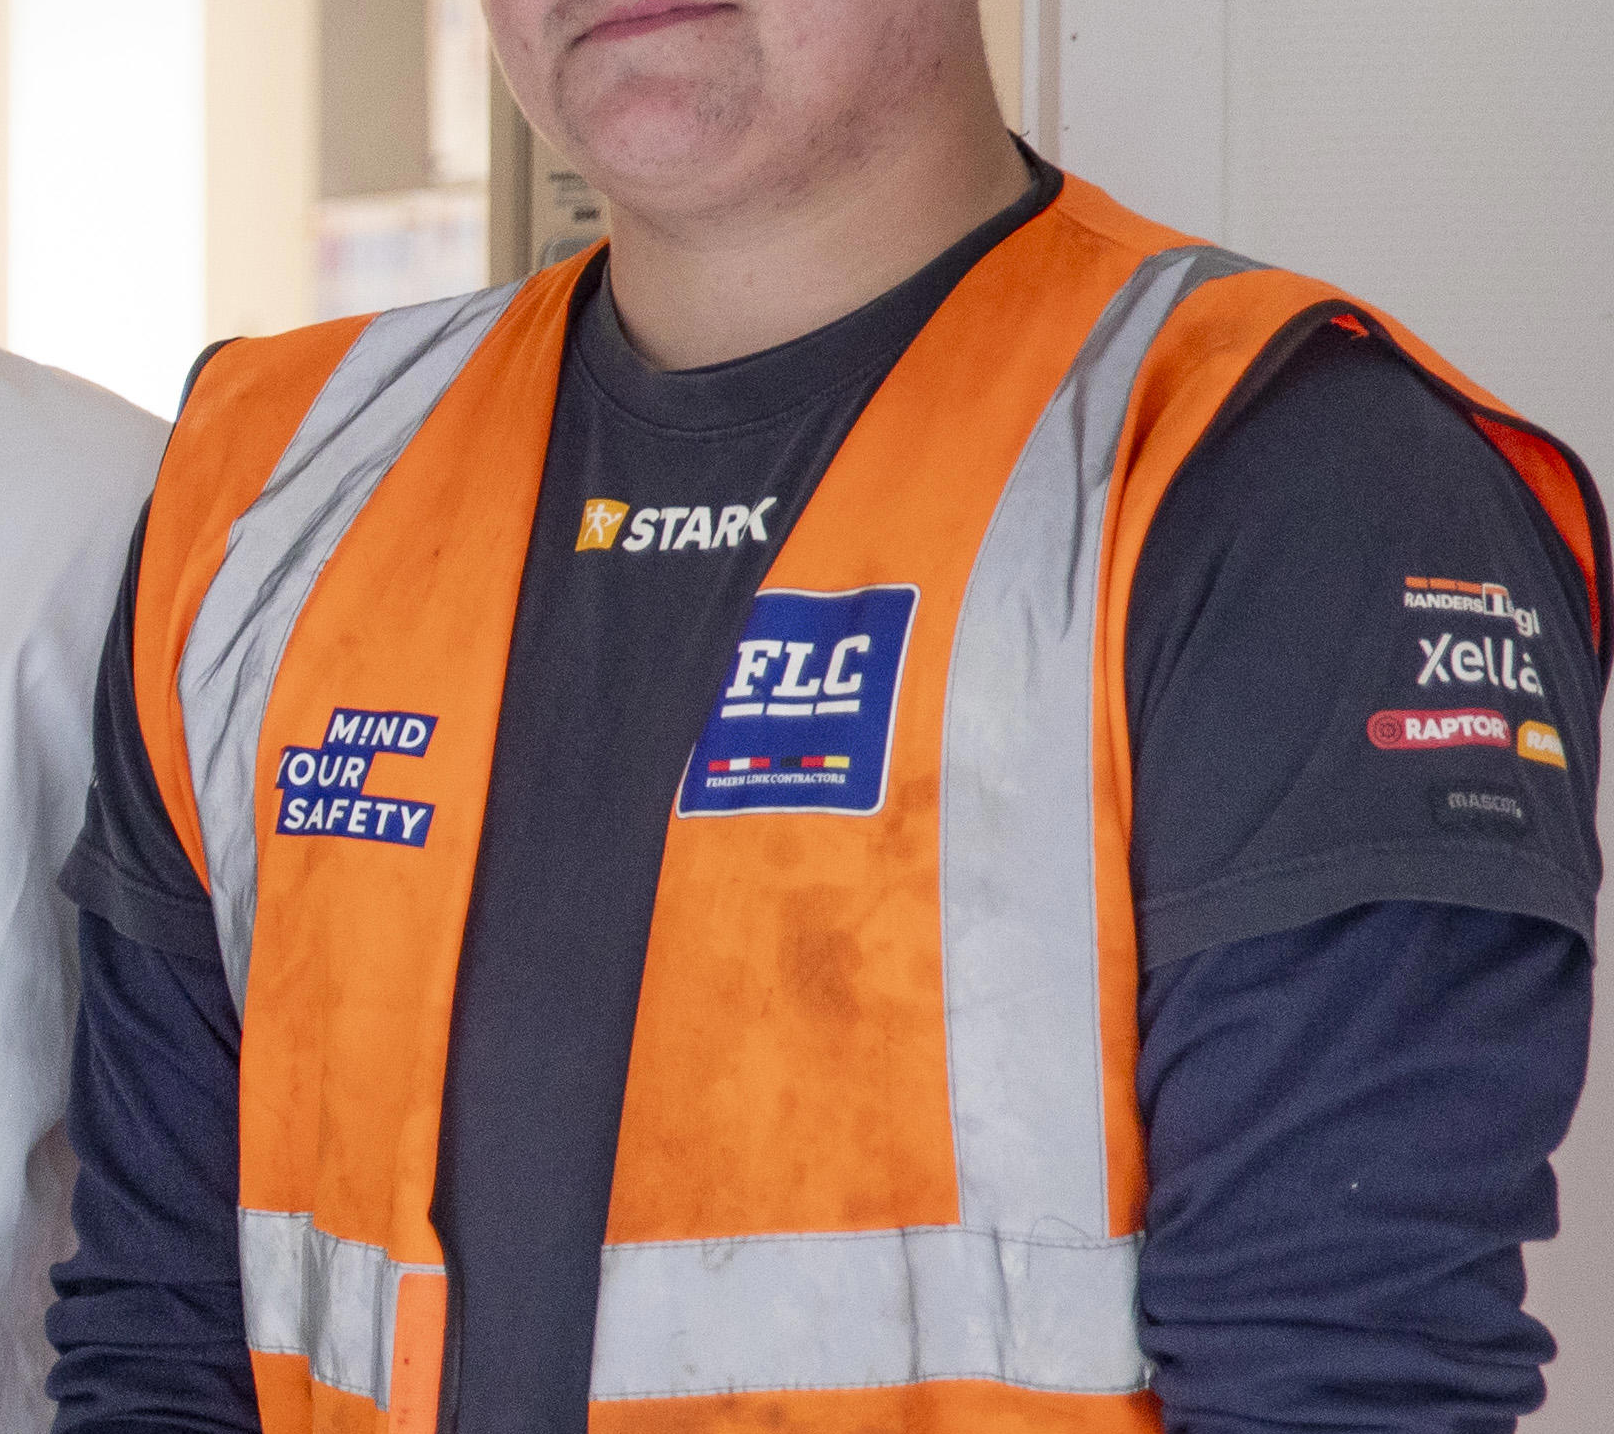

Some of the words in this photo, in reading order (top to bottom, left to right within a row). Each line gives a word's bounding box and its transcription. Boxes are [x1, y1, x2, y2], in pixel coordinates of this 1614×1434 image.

[622, 496, 778, 552] STARK
[1404, 592, 1483, 612] RANDERS
[725, 634, 871, 698] FLC
[1405, 715, 1507, 741] RAPTOR
[706, 775, 745, 788] FEMERN
[746, 773, 770, 785] LINK
[771, 773, 846, 784] CONTRACTORS
[284, 797, 427, 839] SAFETY
